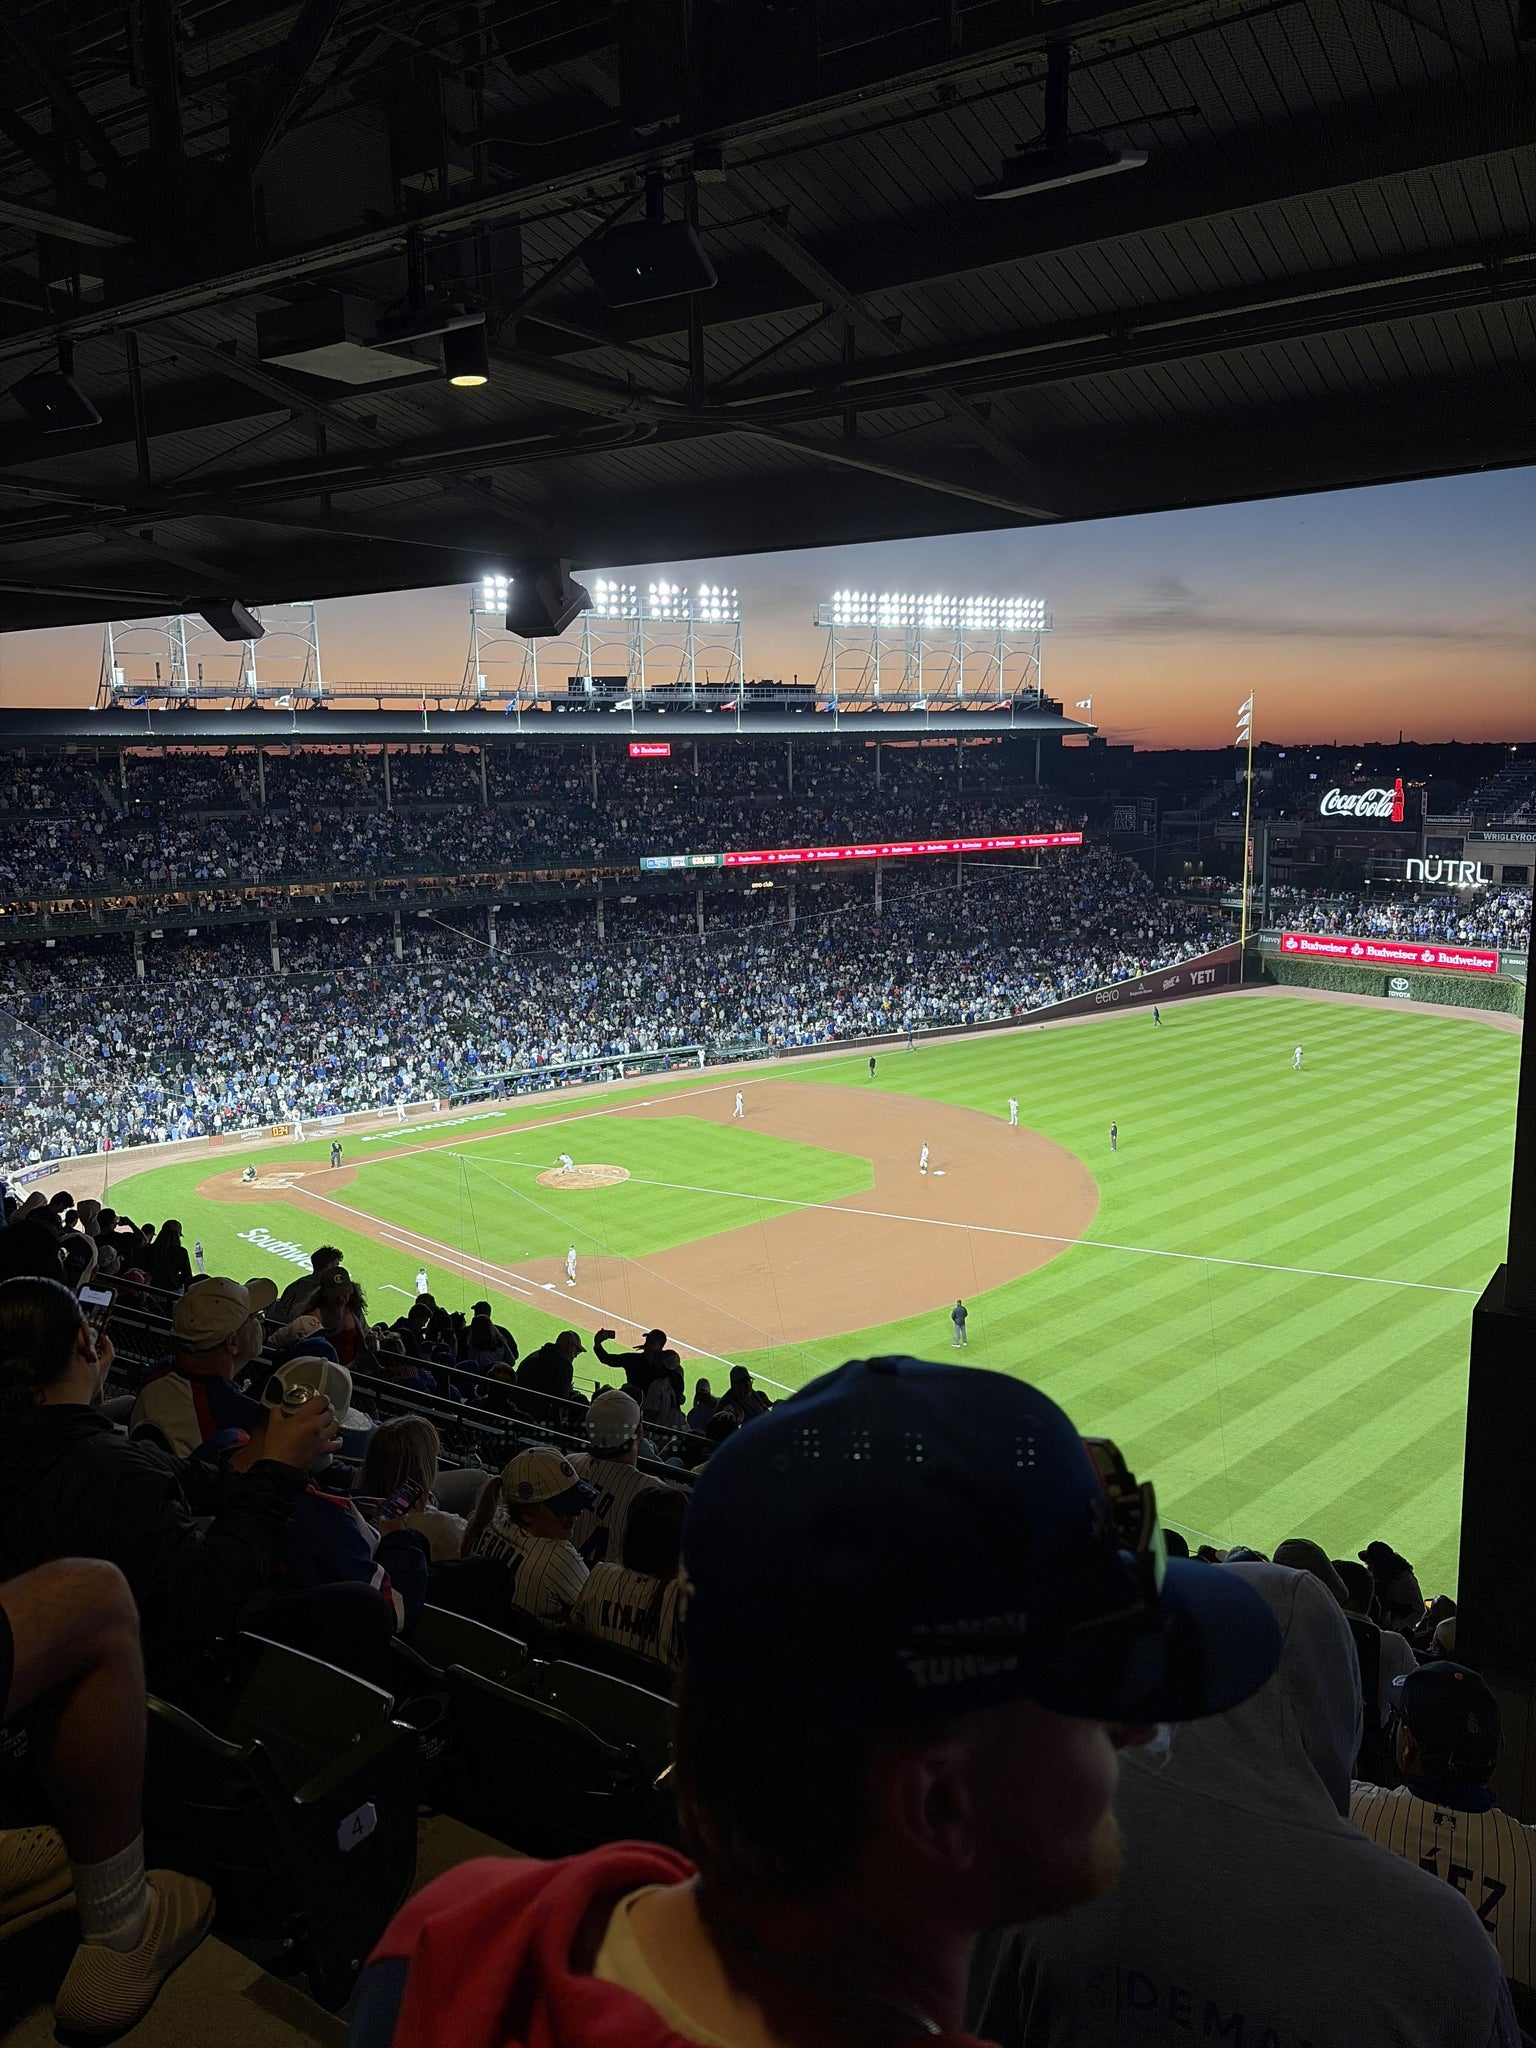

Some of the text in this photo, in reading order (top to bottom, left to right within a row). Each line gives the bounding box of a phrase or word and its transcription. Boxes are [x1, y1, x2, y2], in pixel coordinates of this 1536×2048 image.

[1320, 788, 1397, 818] Coca-Cola
[1260, 934, 1280, 945] Harvey
[1301, 939, 1493, 968] Budweiser Budweiser Budweiser
[1190, 968, 1215, 985] YETI
[1095, 989, 1120, 1004] eero
[1388, 990, 1411, 998] TOYOTA
[352, 1815, 363, 1834] 4
